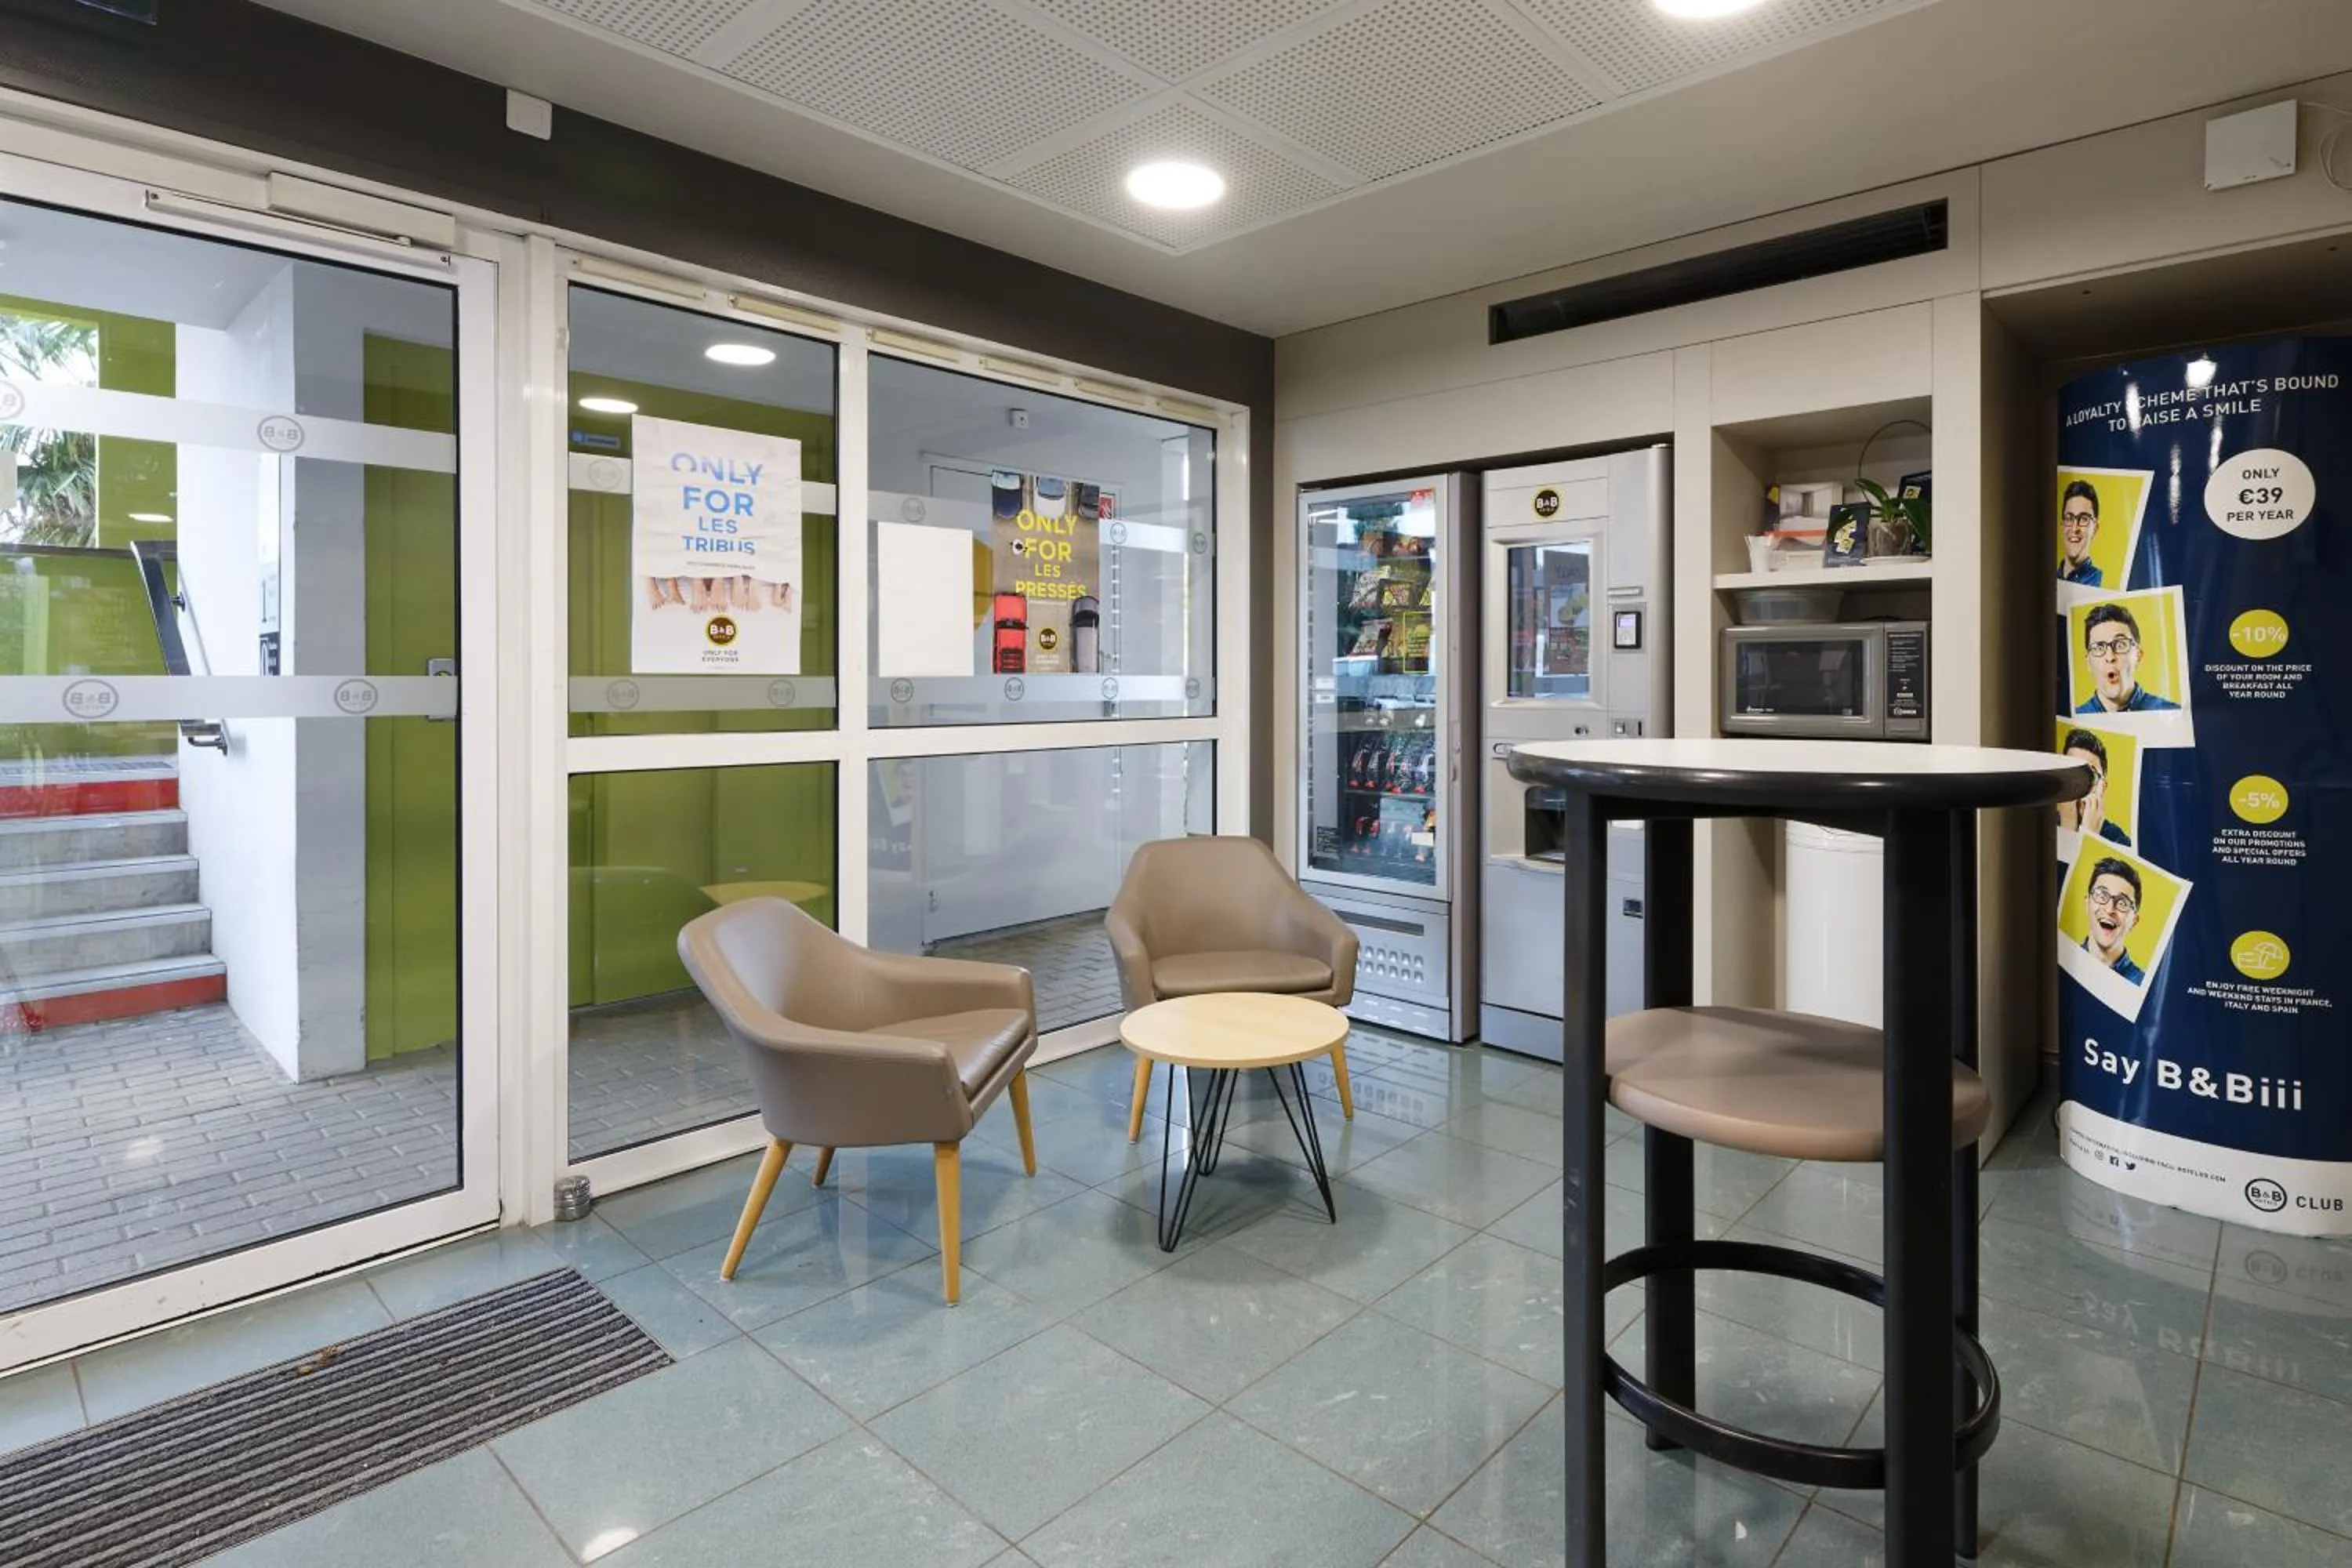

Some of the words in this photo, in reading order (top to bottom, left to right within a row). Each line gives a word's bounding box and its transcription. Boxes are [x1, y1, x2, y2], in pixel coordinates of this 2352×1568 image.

[2066, 414, 2072, 427] A
[2074, 401, 2122, 425] LOYALTY
[2126, 388, 2196, 409] CHEME
[2203, 379, 2268, 399] THAT'S
[2274, 375, 2339, 391] BOUND
[2108, 418, 2126, 431] TO
[2129, 408, 2180, 429] AISE
[2185, 407, 2198, 420] A
[2202, 398, 2262, 418] SMILE
[670, 452, 764, 486] ONLY
[2241, 467, 2281, 480] ONLY
[682, 486, 753, 517] FOR
[2238, 487, 2283, 504] €39
[1016, 510, 1078, 536] ONLY
[2227, 511, 2254, 521] PER
[2259, 509, 2294, 521] YEAR
[698, 517, 738, 535] LES
[1025, 538, 1072, 563] FOR
[1034, 564, 1061, 577] LES
[2232, 627, 2285, 643] -10%
[2238, 792, 2280, 808] -5%
[2221, 829, 2251, 837] EXTRA
[2248, 839, 2306, 848] PROMOTIONS
[2271, 848, 2307, 857] OFFERS
[2265, 857, 2296, 866] ROUND
[2187, 986, 2207, 996] AND
[2208, 989, 2253, 1002] WEEKEND
[2255, 995, 2282, 1004] STAYS
[2295, 998, 2333, 1007] FRANCE,
[2205, 981, 2235, 990] ENJOY
[2237, 984, 2259, 993] FREE
[2262, 986, 2315, 996] WEEKNIGHT
[2224, 1001, 2249, 1010] ITALY
[2251, 1003, 2270, 1012] AND
[2272, 1005, 2299, 1014] SPAIN
[2084, 1037, 2140, 1085] Say
[2157, 1058, 2302, 1111] B&Biii
[2251, 1186, 2282, 1202] B&B
[2296, 1196, 2343, 1211] CLUB
